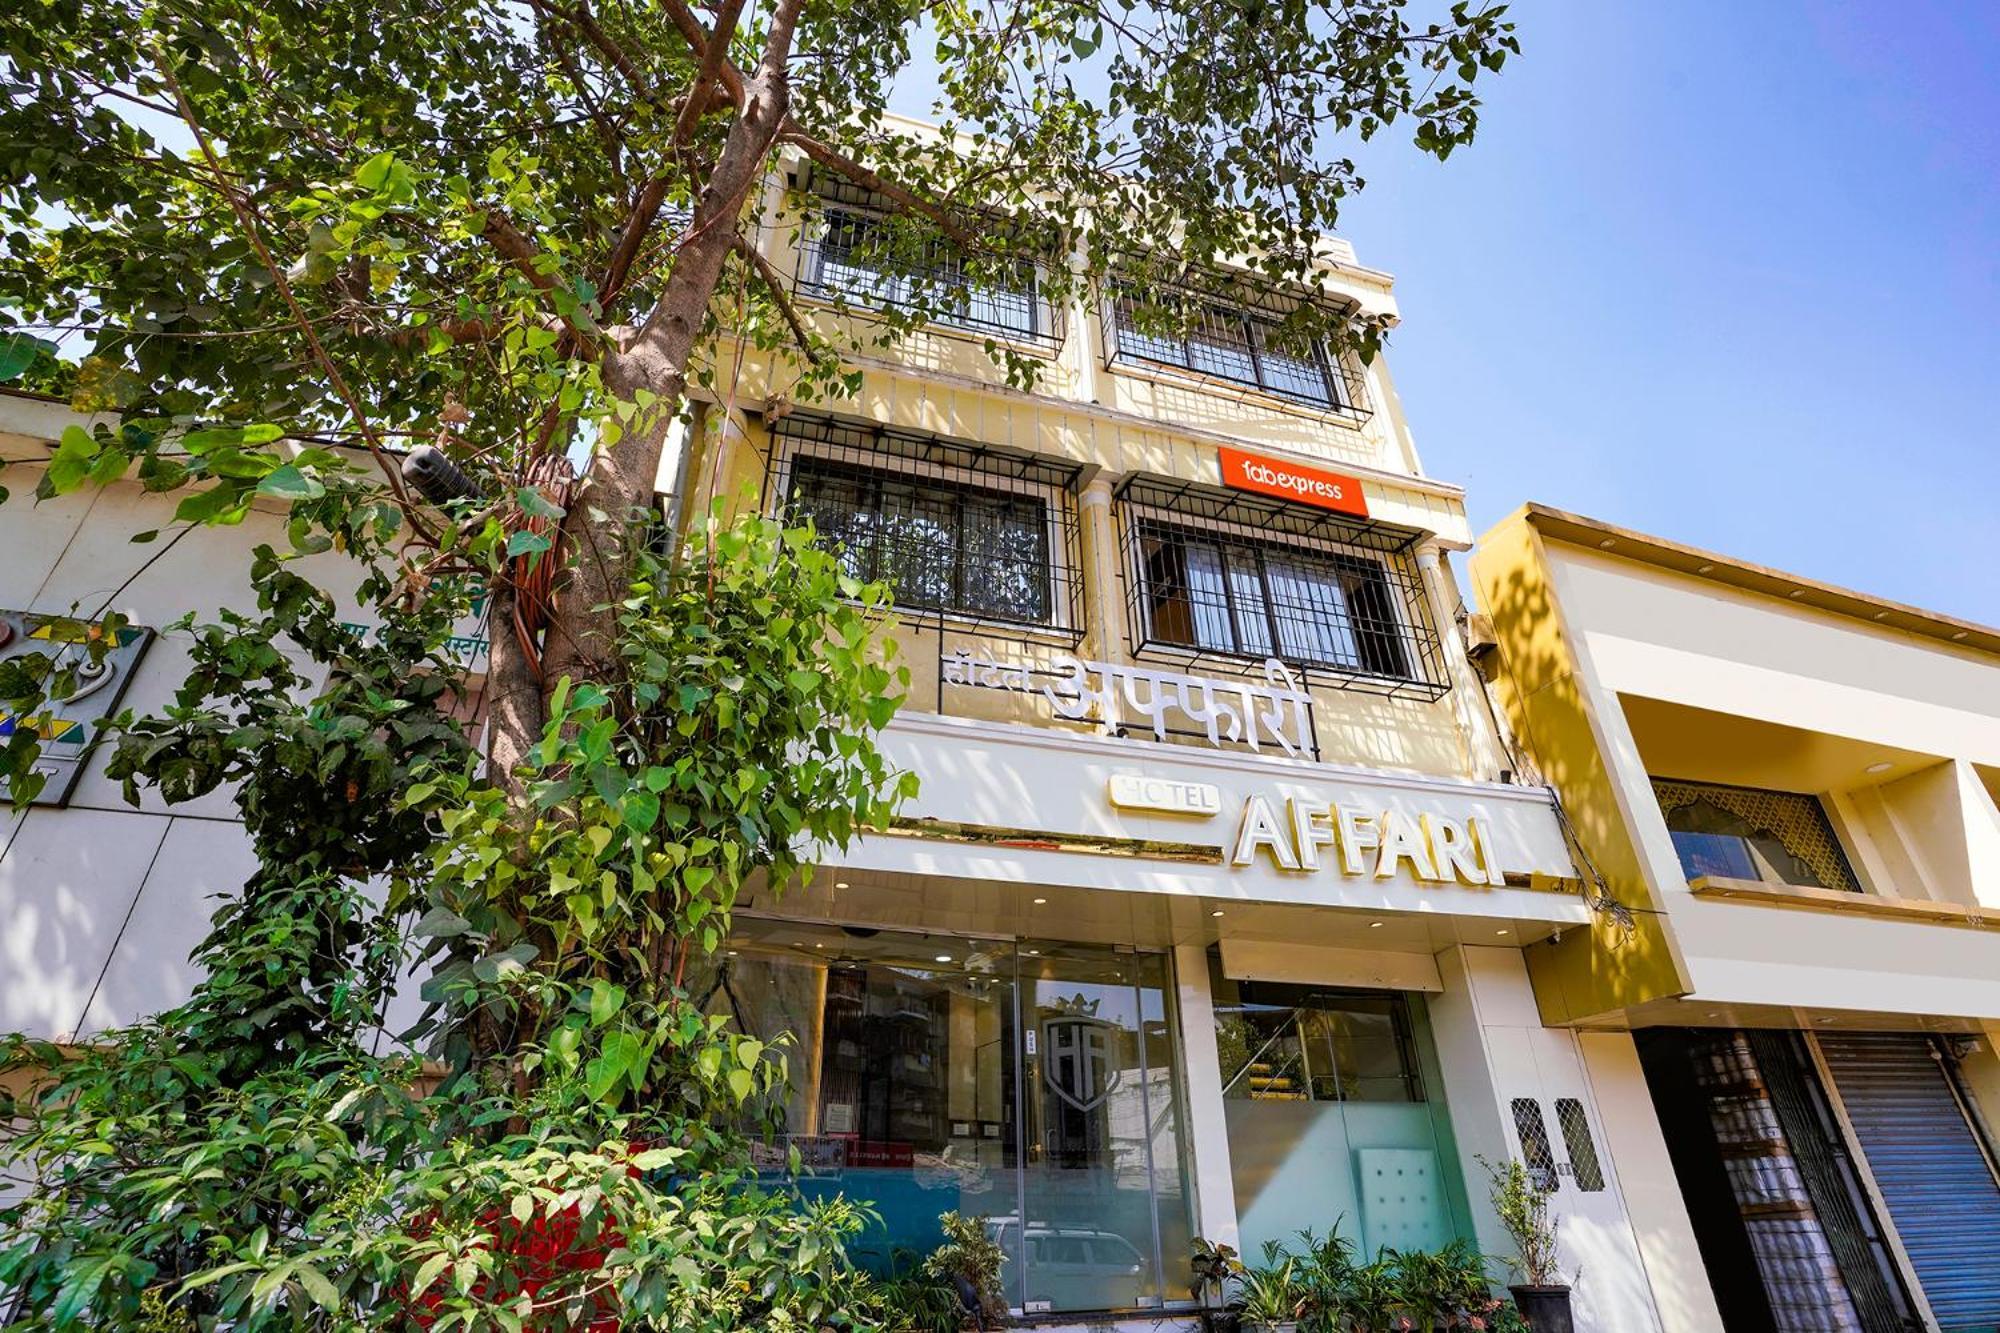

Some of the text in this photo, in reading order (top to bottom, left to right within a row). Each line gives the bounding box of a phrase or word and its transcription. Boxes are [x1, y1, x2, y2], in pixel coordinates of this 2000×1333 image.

[1242, 460, 1343, 500] fabexpress
[940, 643, 1034, 693] हॉटेल
[1232, 793, 1506, 886] AFFARI
